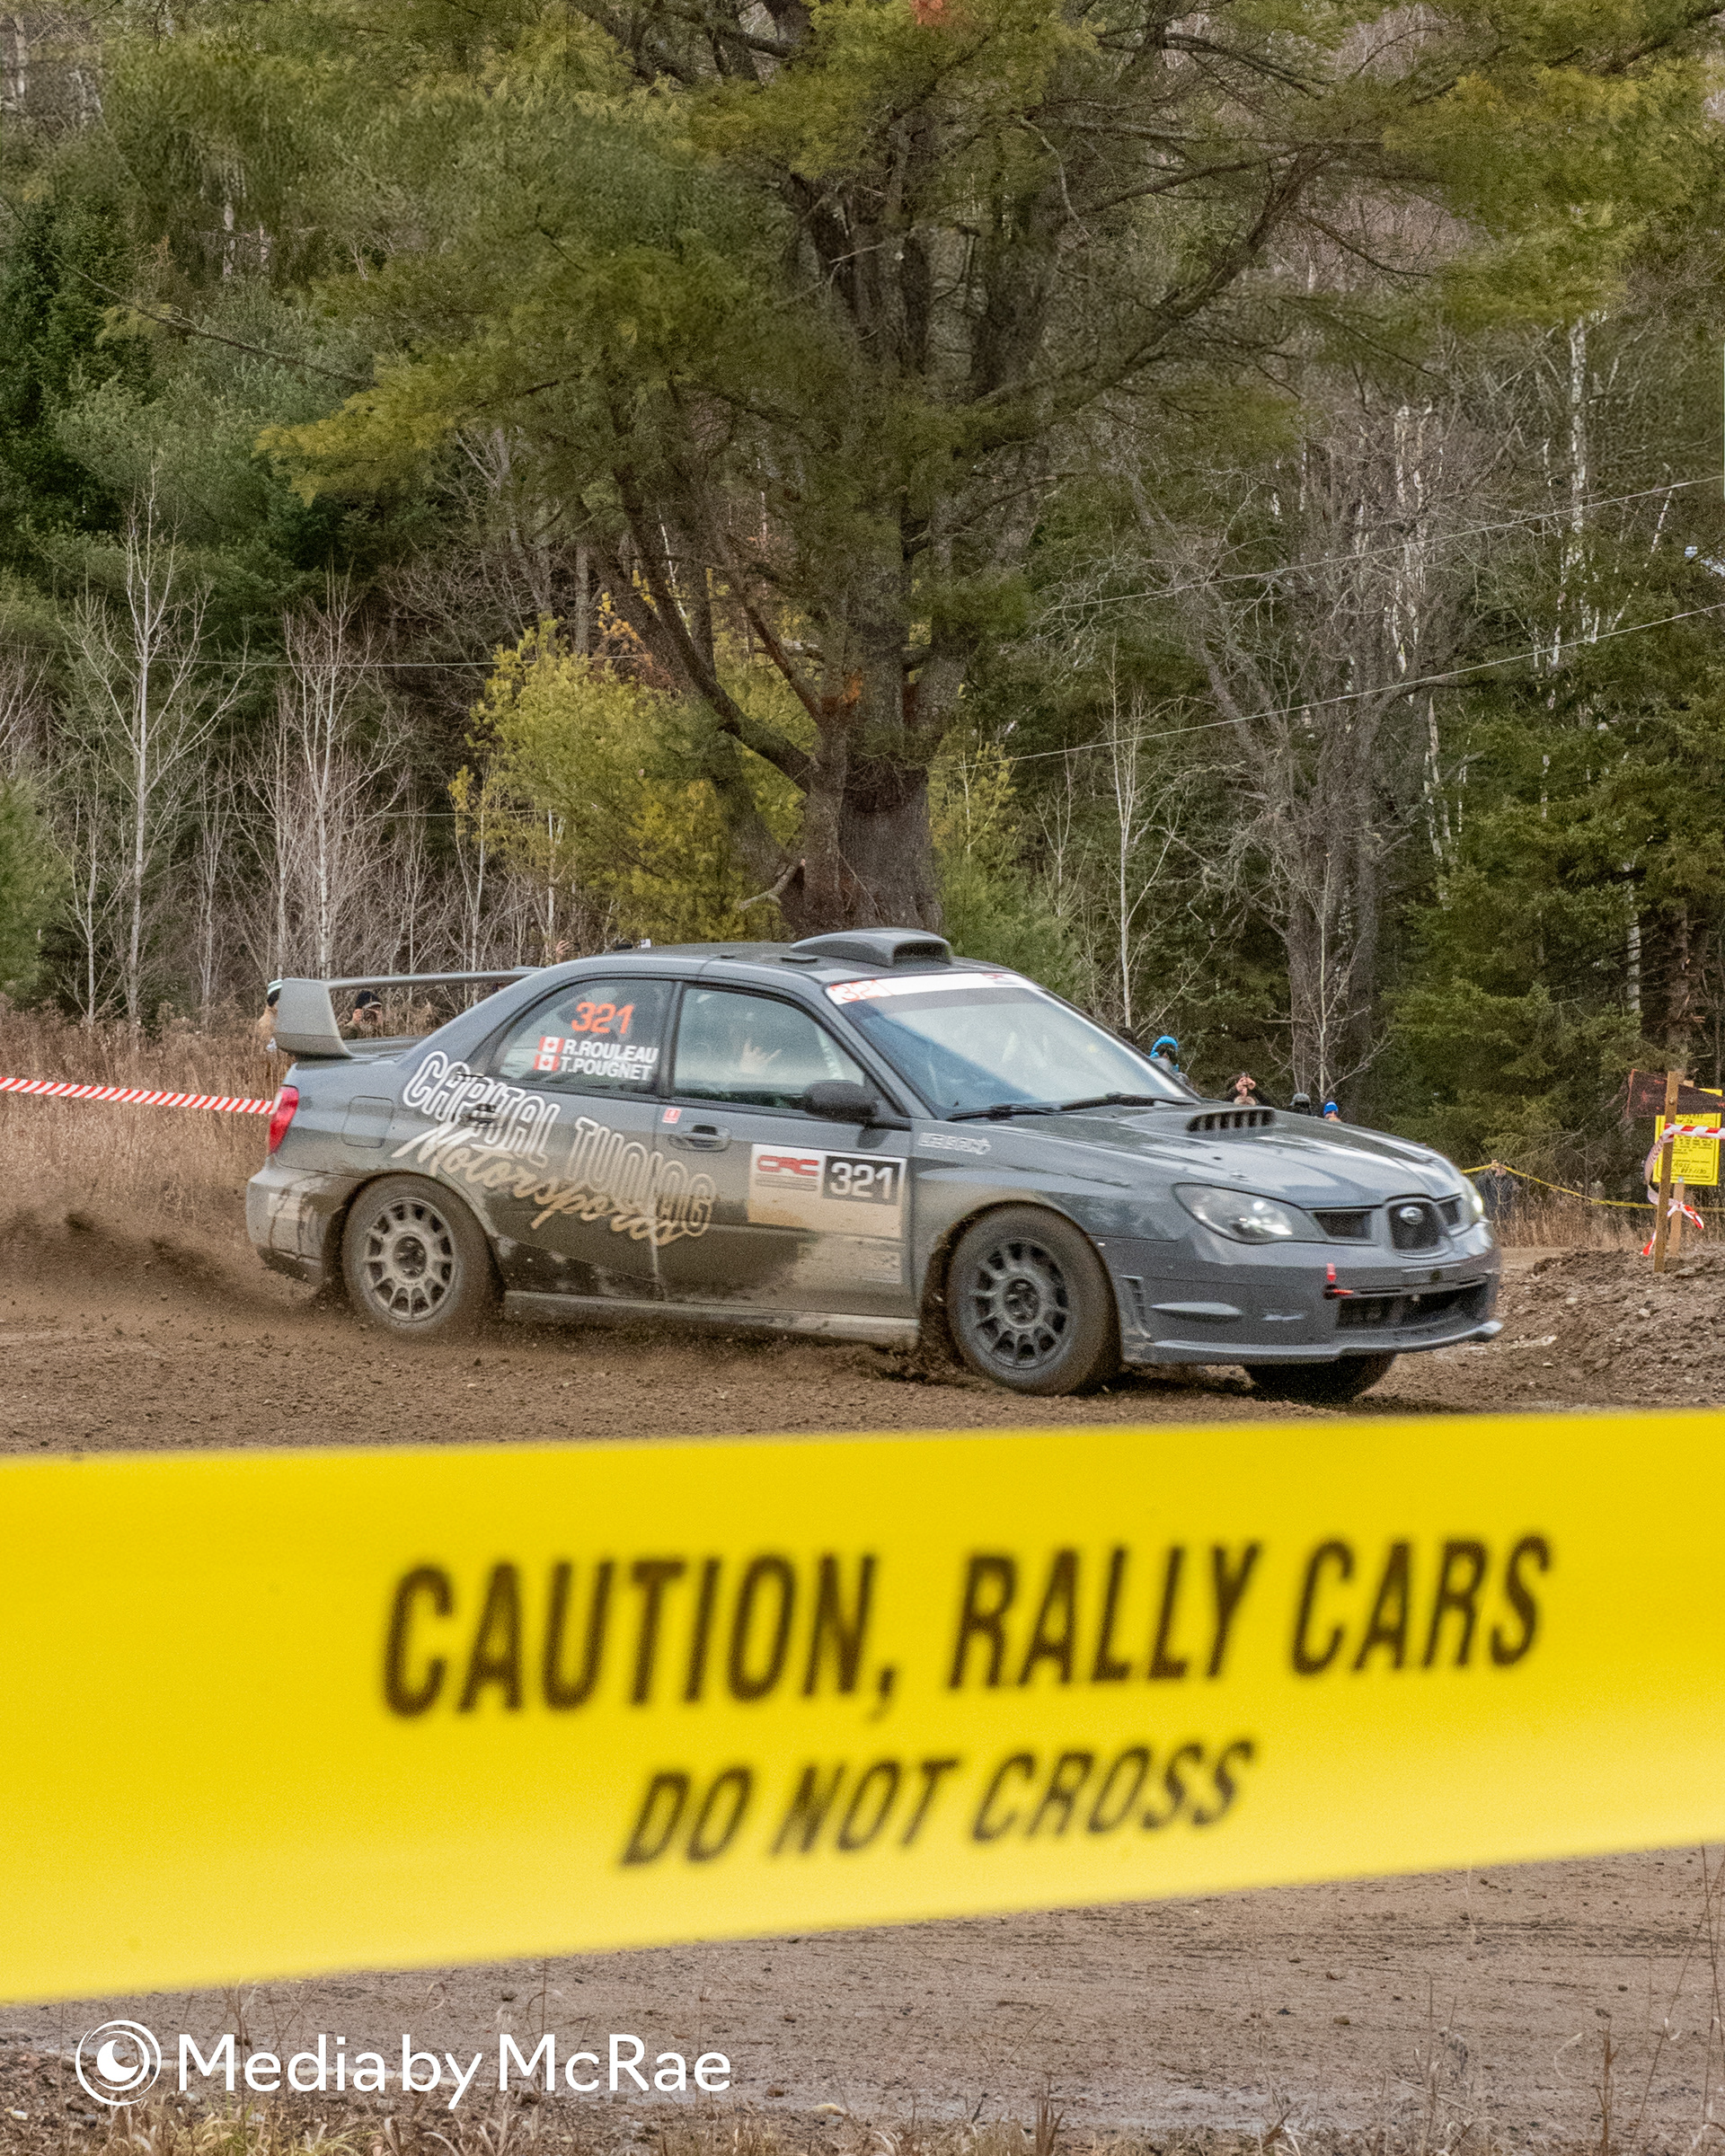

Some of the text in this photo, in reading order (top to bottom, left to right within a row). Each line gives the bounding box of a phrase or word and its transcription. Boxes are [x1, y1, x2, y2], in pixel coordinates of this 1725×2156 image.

[571, 1002, 635, 1034] 321
[558, 1056, 653, 1081] T.POUGNET
[562, 1038, 659, 1064] R.ROULEAU
[402, 1050, 716, 1237] CAPITAL TUNING
[828, 1162, 894, 1200] 321
[384, 1531, 1552, 1723] CAUTION, RALLY CARS
[618, 1736, 1258, 1869] DO NOT CROSS
